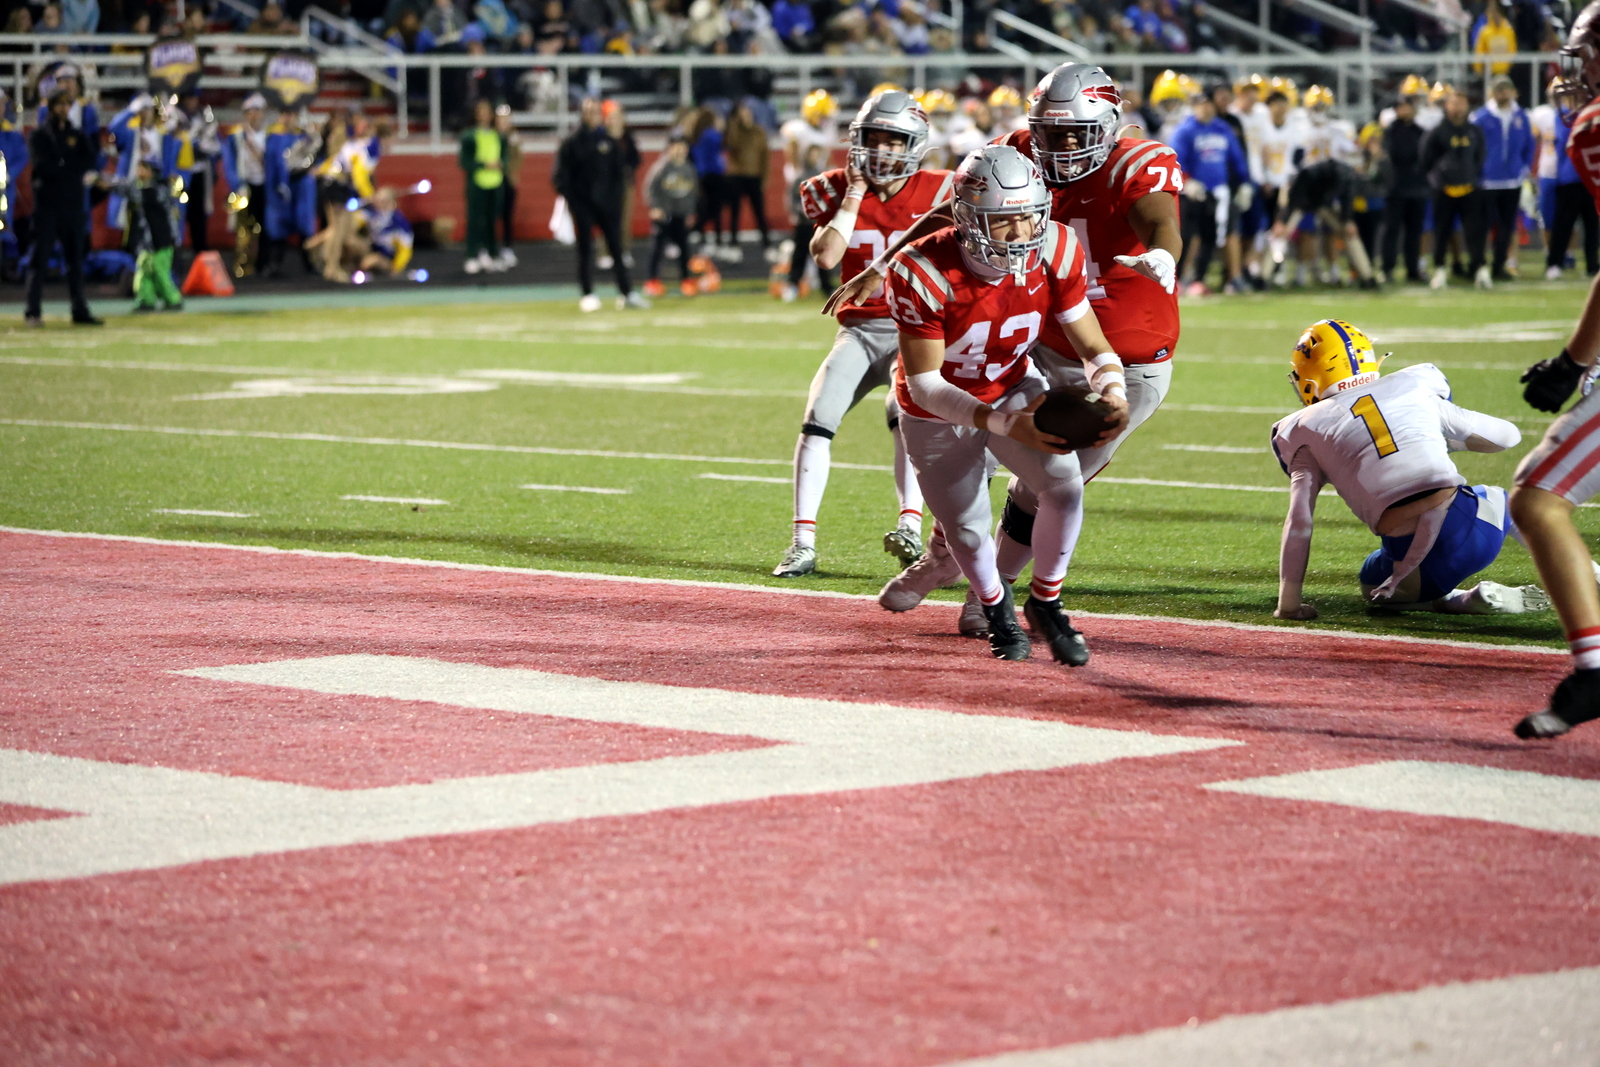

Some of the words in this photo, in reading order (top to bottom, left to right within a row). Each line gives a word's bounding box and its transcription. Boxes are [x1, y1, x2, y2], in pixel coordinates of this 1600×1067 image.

[1147, 166, 1184, 193] 74
[886, 286, 923, 326] 43
[943, 310, 1042, 382] 43
[1337, 373, 1376, 392] Riddell
[1350, 392, 1399, 459] 1
